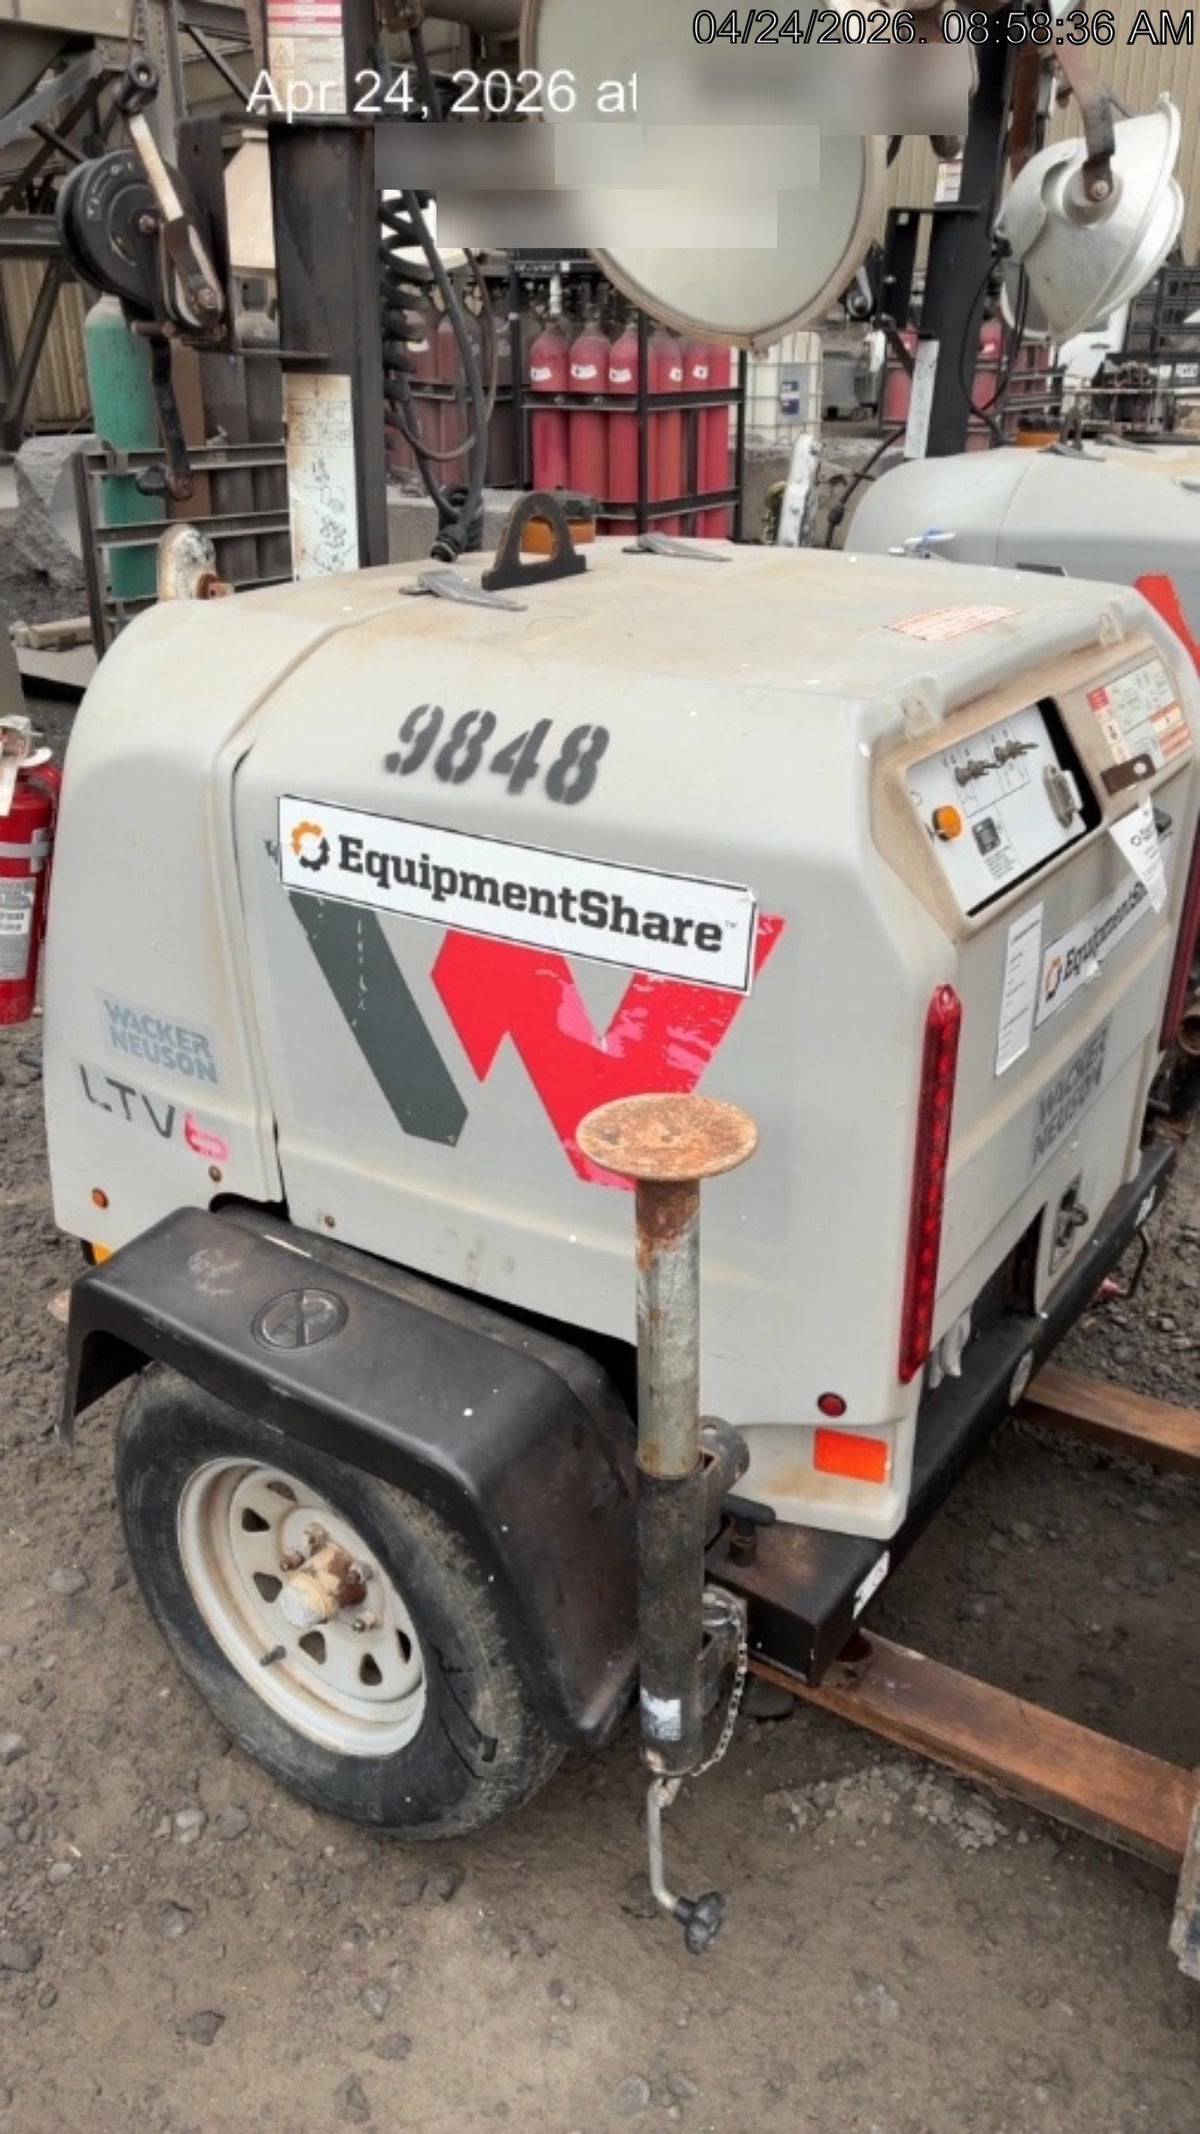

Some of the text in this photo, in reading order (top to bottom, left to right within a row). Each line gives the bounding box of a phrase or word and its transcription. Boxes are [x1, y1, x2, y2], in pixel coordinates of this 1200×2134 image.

[383, 702, 612, 807] 9848
[103, 999, 213, 1061] WACKER
[109, 1024, 219, 1085] NEUSON
